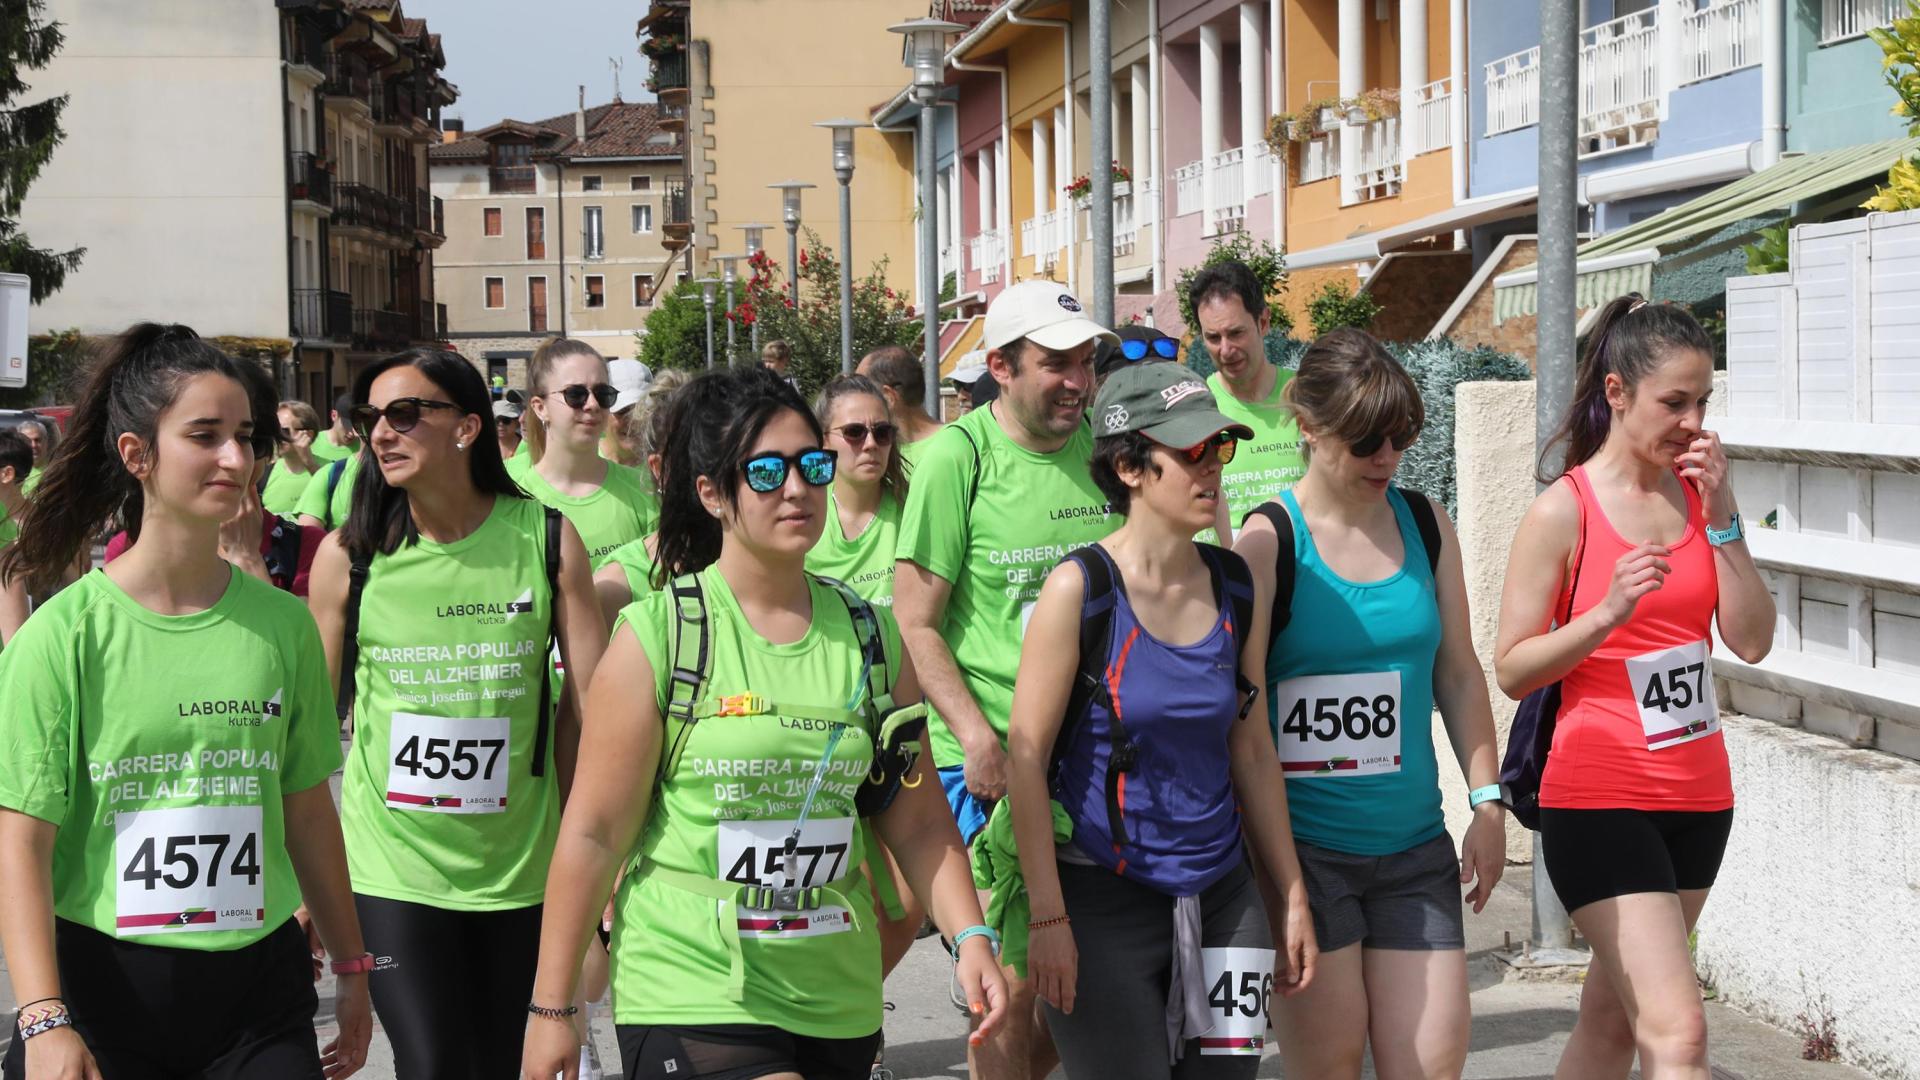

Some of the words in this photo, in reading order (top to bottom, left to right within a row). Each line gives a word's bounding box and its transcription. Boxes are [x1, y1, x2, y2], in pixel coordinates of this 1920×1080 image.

[1250, 441, 1294, 454] LABORAL
[1221, 471, 1262, 487] RRERA
[1050, 505, 1102, 520] LABORAL
[990, 545, 1064, 565] CARRERA
[853, 566, 895, 583] LABORA
[1006, 568, 1037, 583] DEL
[437, 603, 504, 617] LABORAL
[477, 616, 505, 625] kutxa
[372, 645, 451, 663] CARRERA
[456, 640, 534, 660] POPULAR
[389, 669, 421, 685] DEL
[424, 663, 522, 684] ALZHEIMER
[482, 683, 526, 700] Arregui
[1642, 661, 1704, 713] 457
[179, 700, 260, 716] LABORAL
[228, 717, 261, 727] kutxa
[1283, 695, 1396, 742] 4568
[89, 751, 195, 781] CARRERA
[395, 735, 505, 781] 4557
[1362, 756, 1389, 765] LABORAL
[693, 759, 792, 777] CARRERA
[110, 782, 150, 804] DEL
[156, 776, 261, 799] ALZHEIME
[714, 783, 752, 802] DEL
[124, 832, 260, 890] 4574
[221, 909, 252, 917] LABORAL
[813, 913, 840, 923] LABORAL
[1208, 971, 1273, 1018] 456
